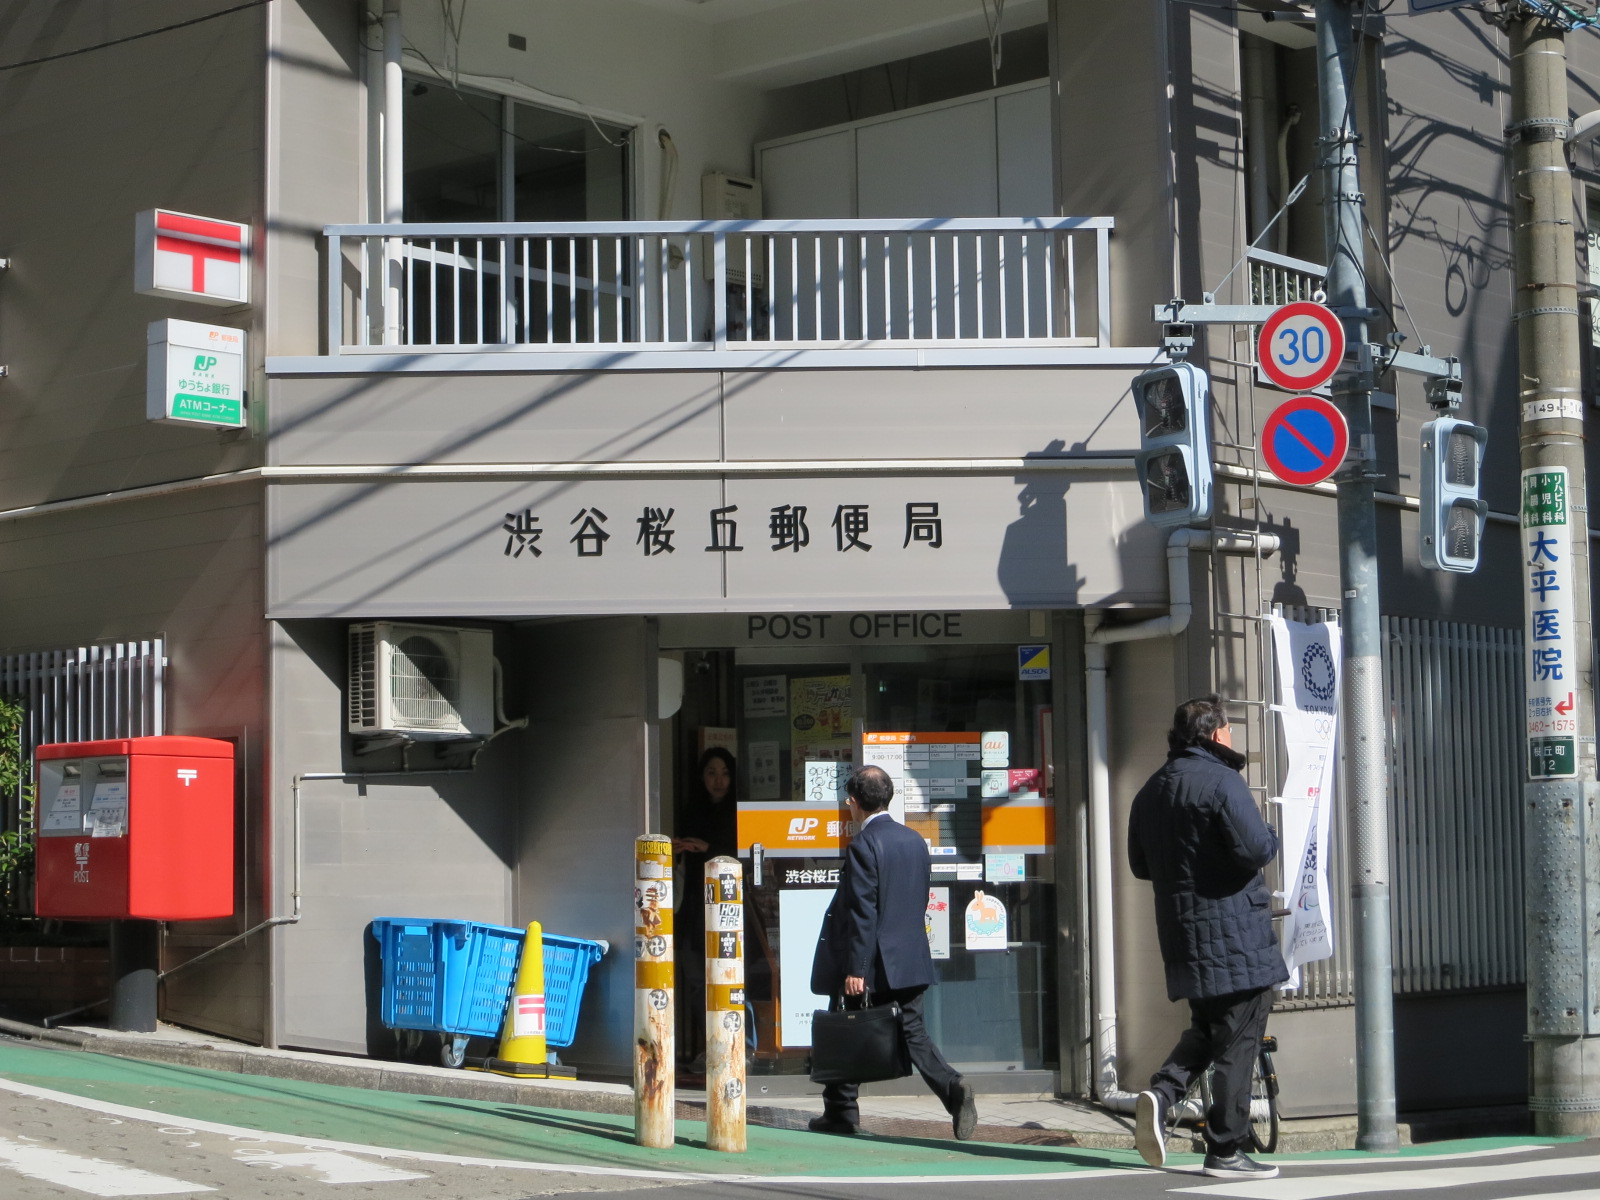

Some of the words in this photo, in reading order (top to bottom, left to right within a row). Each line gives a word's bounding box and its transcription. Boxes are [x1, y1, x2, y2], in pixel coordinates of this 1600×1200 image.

[1278, 326, 1324, 366] 30
[178, 379, 230, 395] ゆうちょ銀行
[179, 399, 235, 413] ATMコーナー
[1541, 474, 1552, 523] 小児科
[1554, 474, 1565, 523] リハビリ科
[502, 502, 943, 559] 渋谷桜丘郵便局
[1529, 531, 1563, 682] 大平医院
[748, 614, 832, 640] POST
[850, 612, 962, 638] OFFICE
[1534, 745, 1565, 757] 桜丘町
[788, 818, 819, 834] JP
[73, 871, 89, 883] POST
[721, 904, 740, 916] HOT
[721, 916, 739, 926] FIRE
